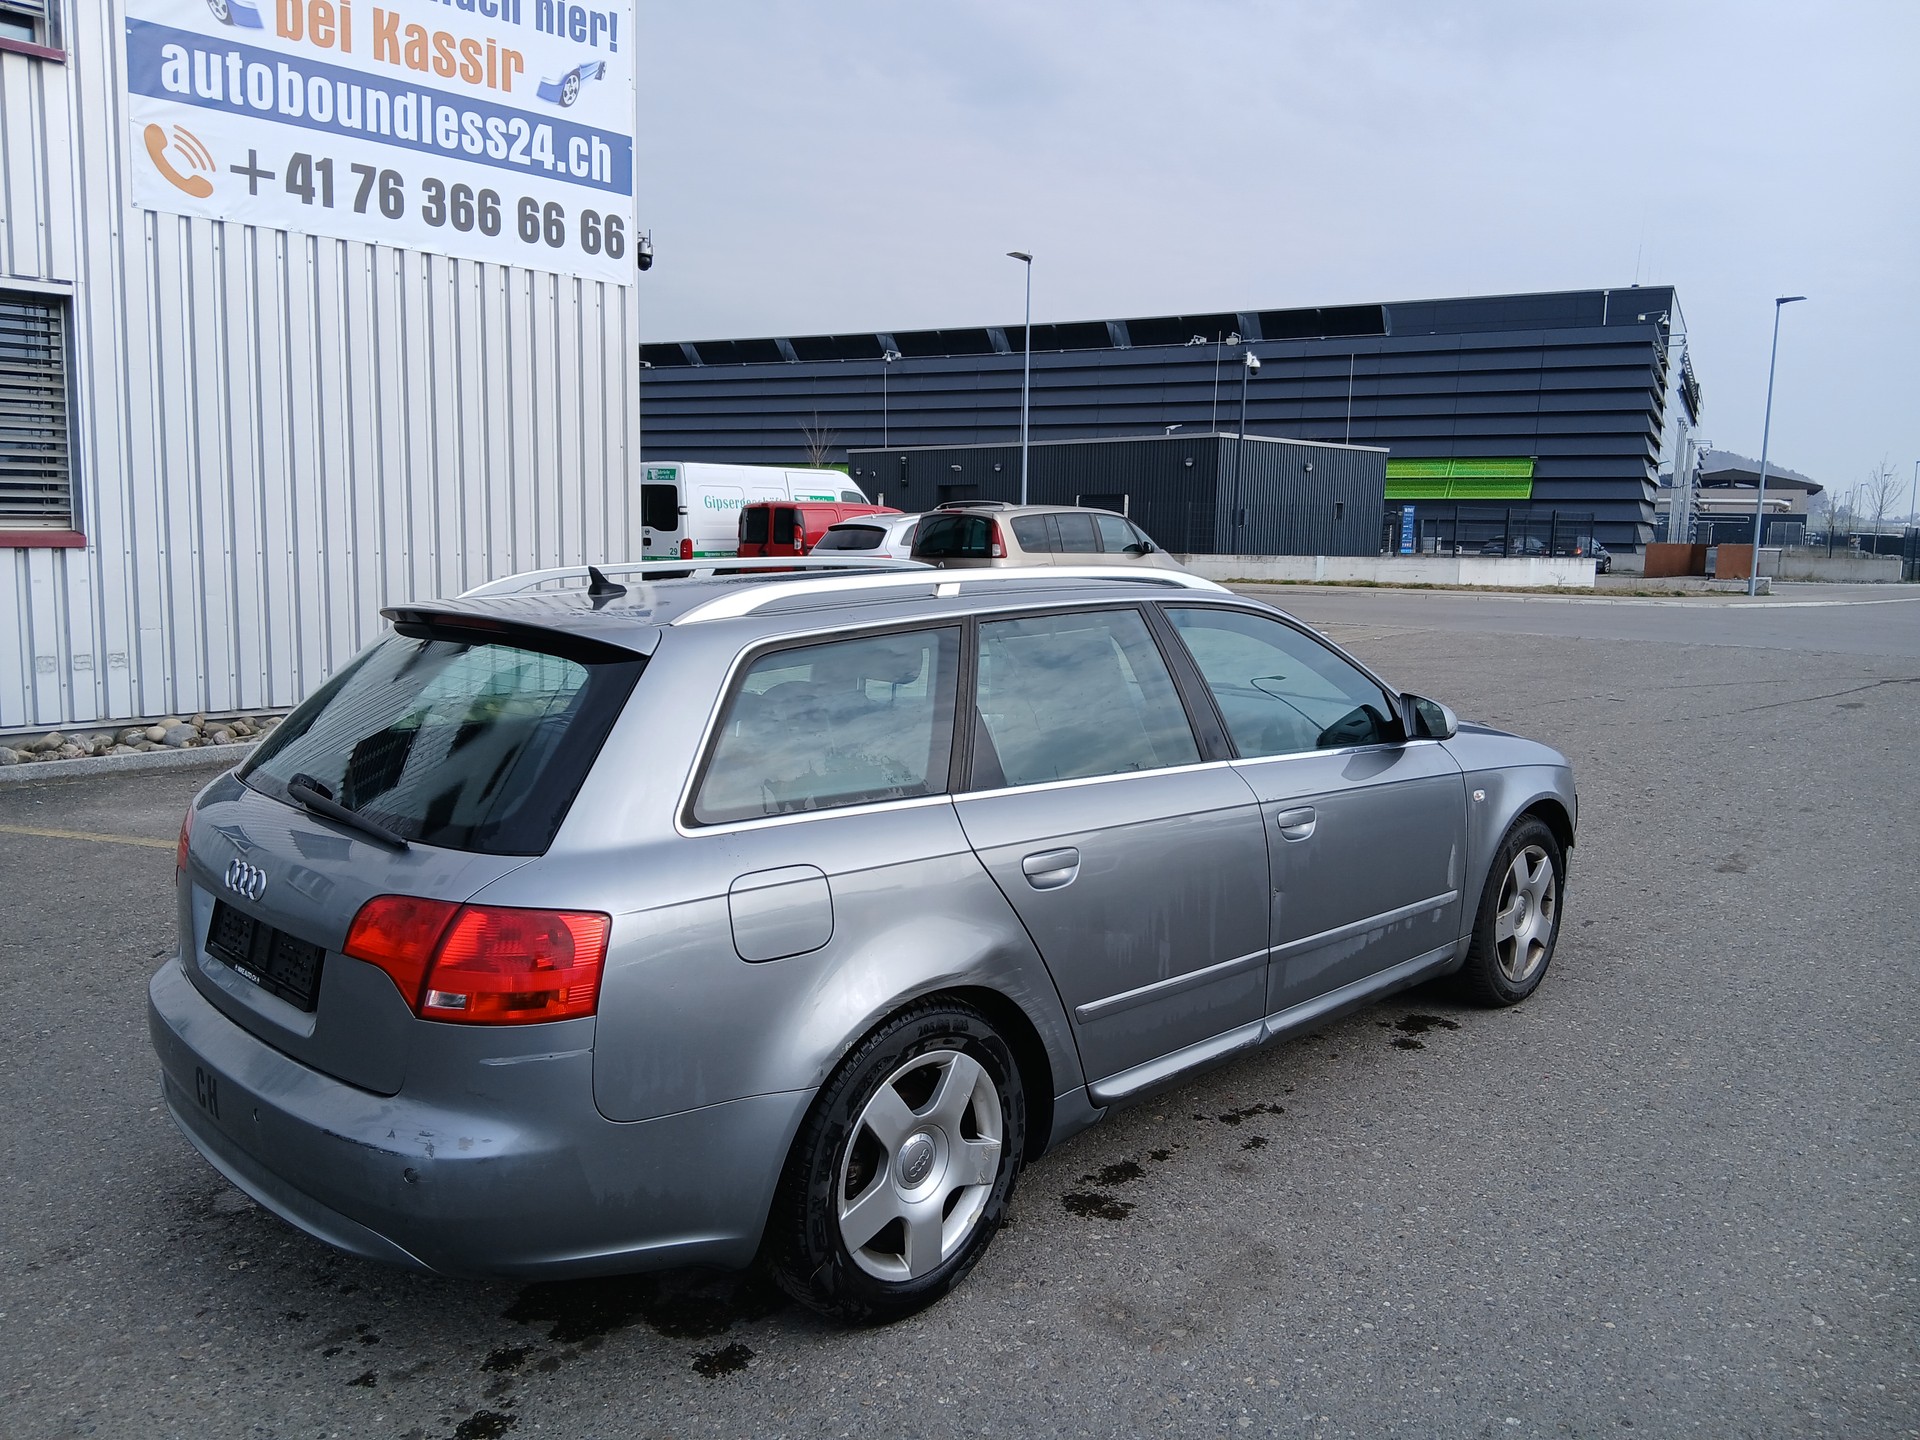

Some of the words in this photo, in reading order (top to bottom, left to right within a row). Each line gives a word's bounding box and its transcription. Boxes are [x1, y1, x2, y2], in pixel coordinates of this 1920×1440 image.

[276, 0, 351, 53] bei
[372, 7, 524, 93] Kassir
[535, 0, 617, 53] hier!
[161, 43, 612, 184] autoboundless24.ch
[285, 152, 334, 209] 41
[350, 162, 405, 220] 76
[421, 177, 502, 238] 366
[516, 195, 566, 249] 66
[579, 208, 625, 261] 66
[669, 547, 678, 555] 29
[195, 1066, 220, 1120] CH
